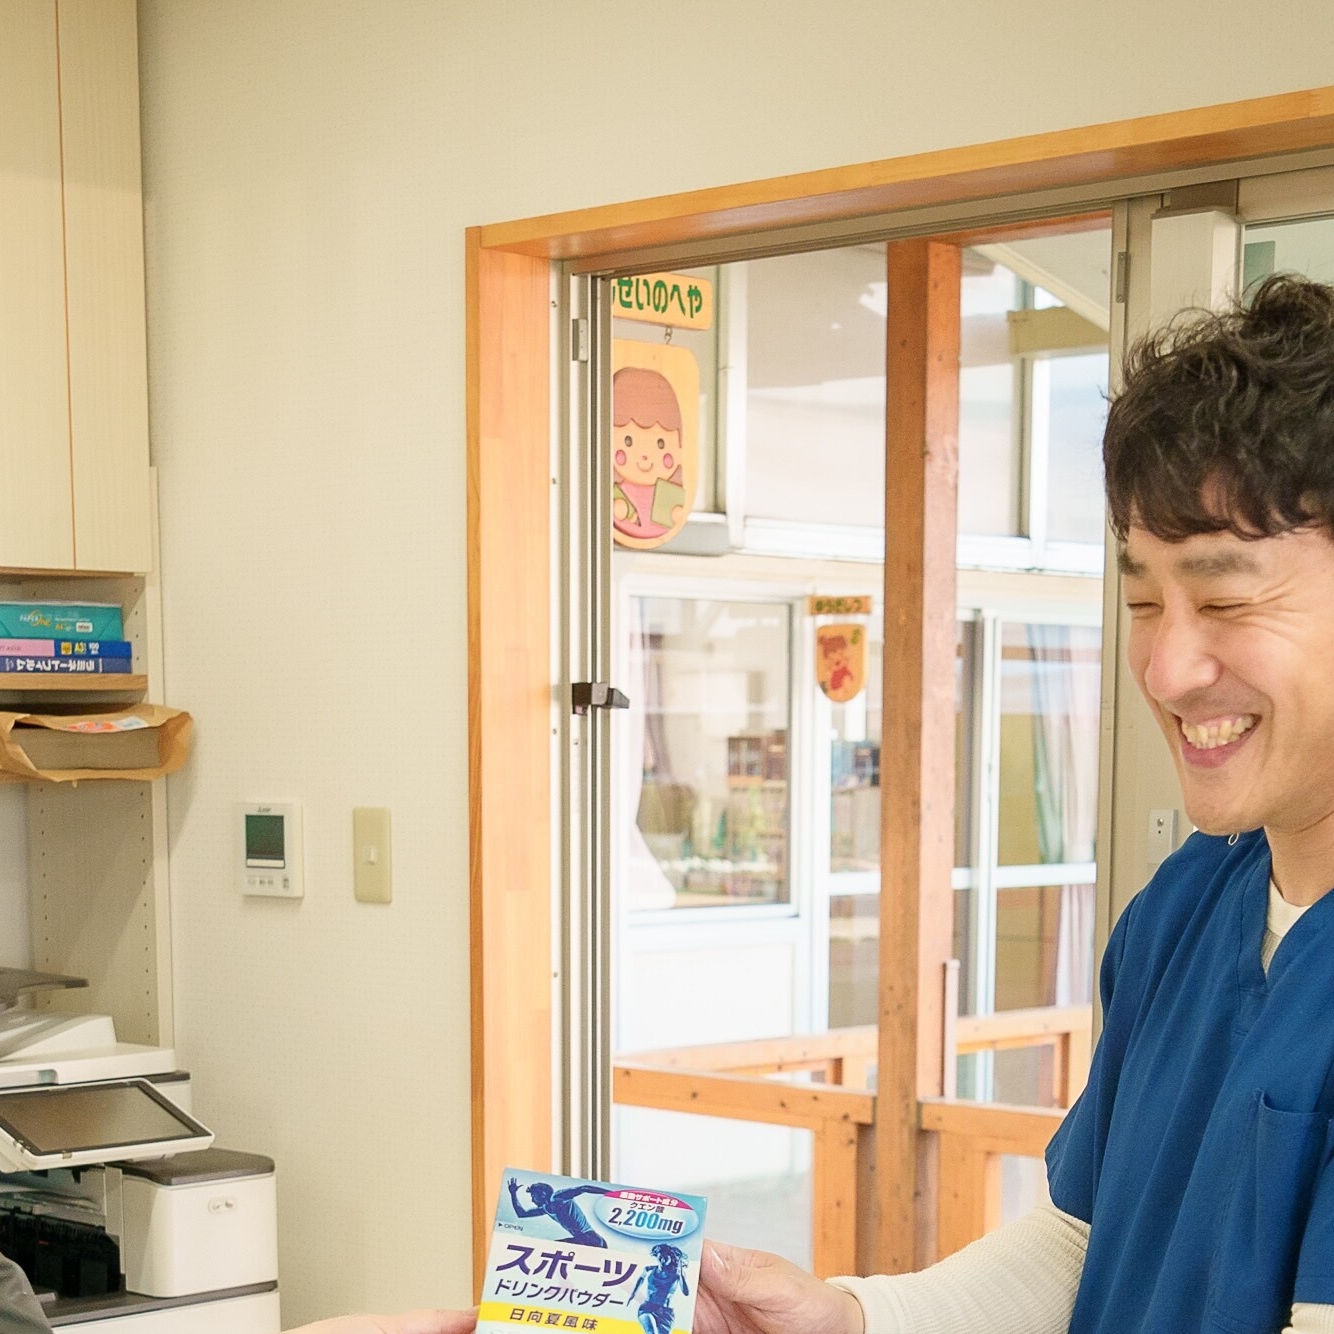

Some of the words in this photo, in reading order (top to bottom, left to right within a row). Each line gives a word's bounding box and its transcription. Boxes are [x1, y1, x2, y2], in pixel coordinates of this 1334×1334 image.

[612, 277, 703, 319] せいのへや
[608, 1207, 684, 1235] 2,200mg
[630, 1202, 665, 1213] クエン酸
[504, 1223, 524, 1232] OPEN
[495, 1243, 638, 1287] スポーツ
[494, 1278, 624, 1308] ドリンクパウダー
[509, 1308, 599, 1331] 日向夏風味
